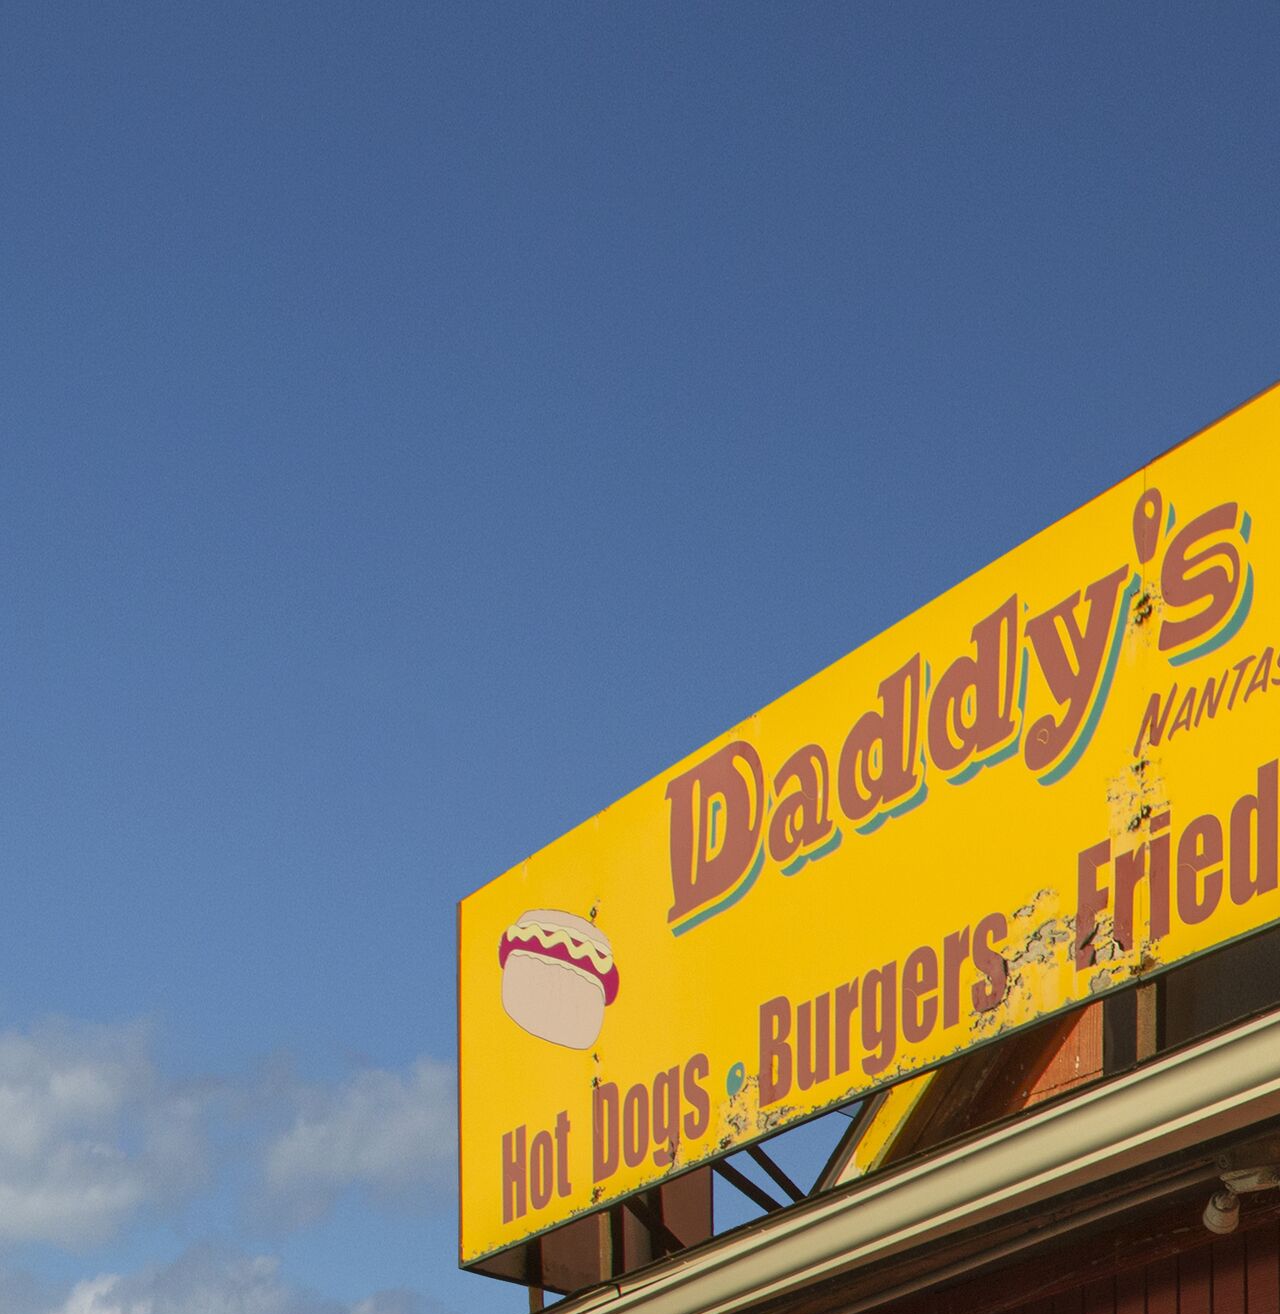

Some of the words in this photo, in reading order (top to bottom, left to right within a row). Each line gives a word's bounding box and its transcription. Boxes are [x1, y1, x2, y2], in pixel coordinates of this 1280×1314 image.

[666, 488, 1250, 932] Daddy's
[502, 1110, 572, 1226] Hot
[593, 1053, 711, 1188] Dogs
[759, 911, 1010, 1108] Burgers
[1076, 758, 1279, 973] Fried
